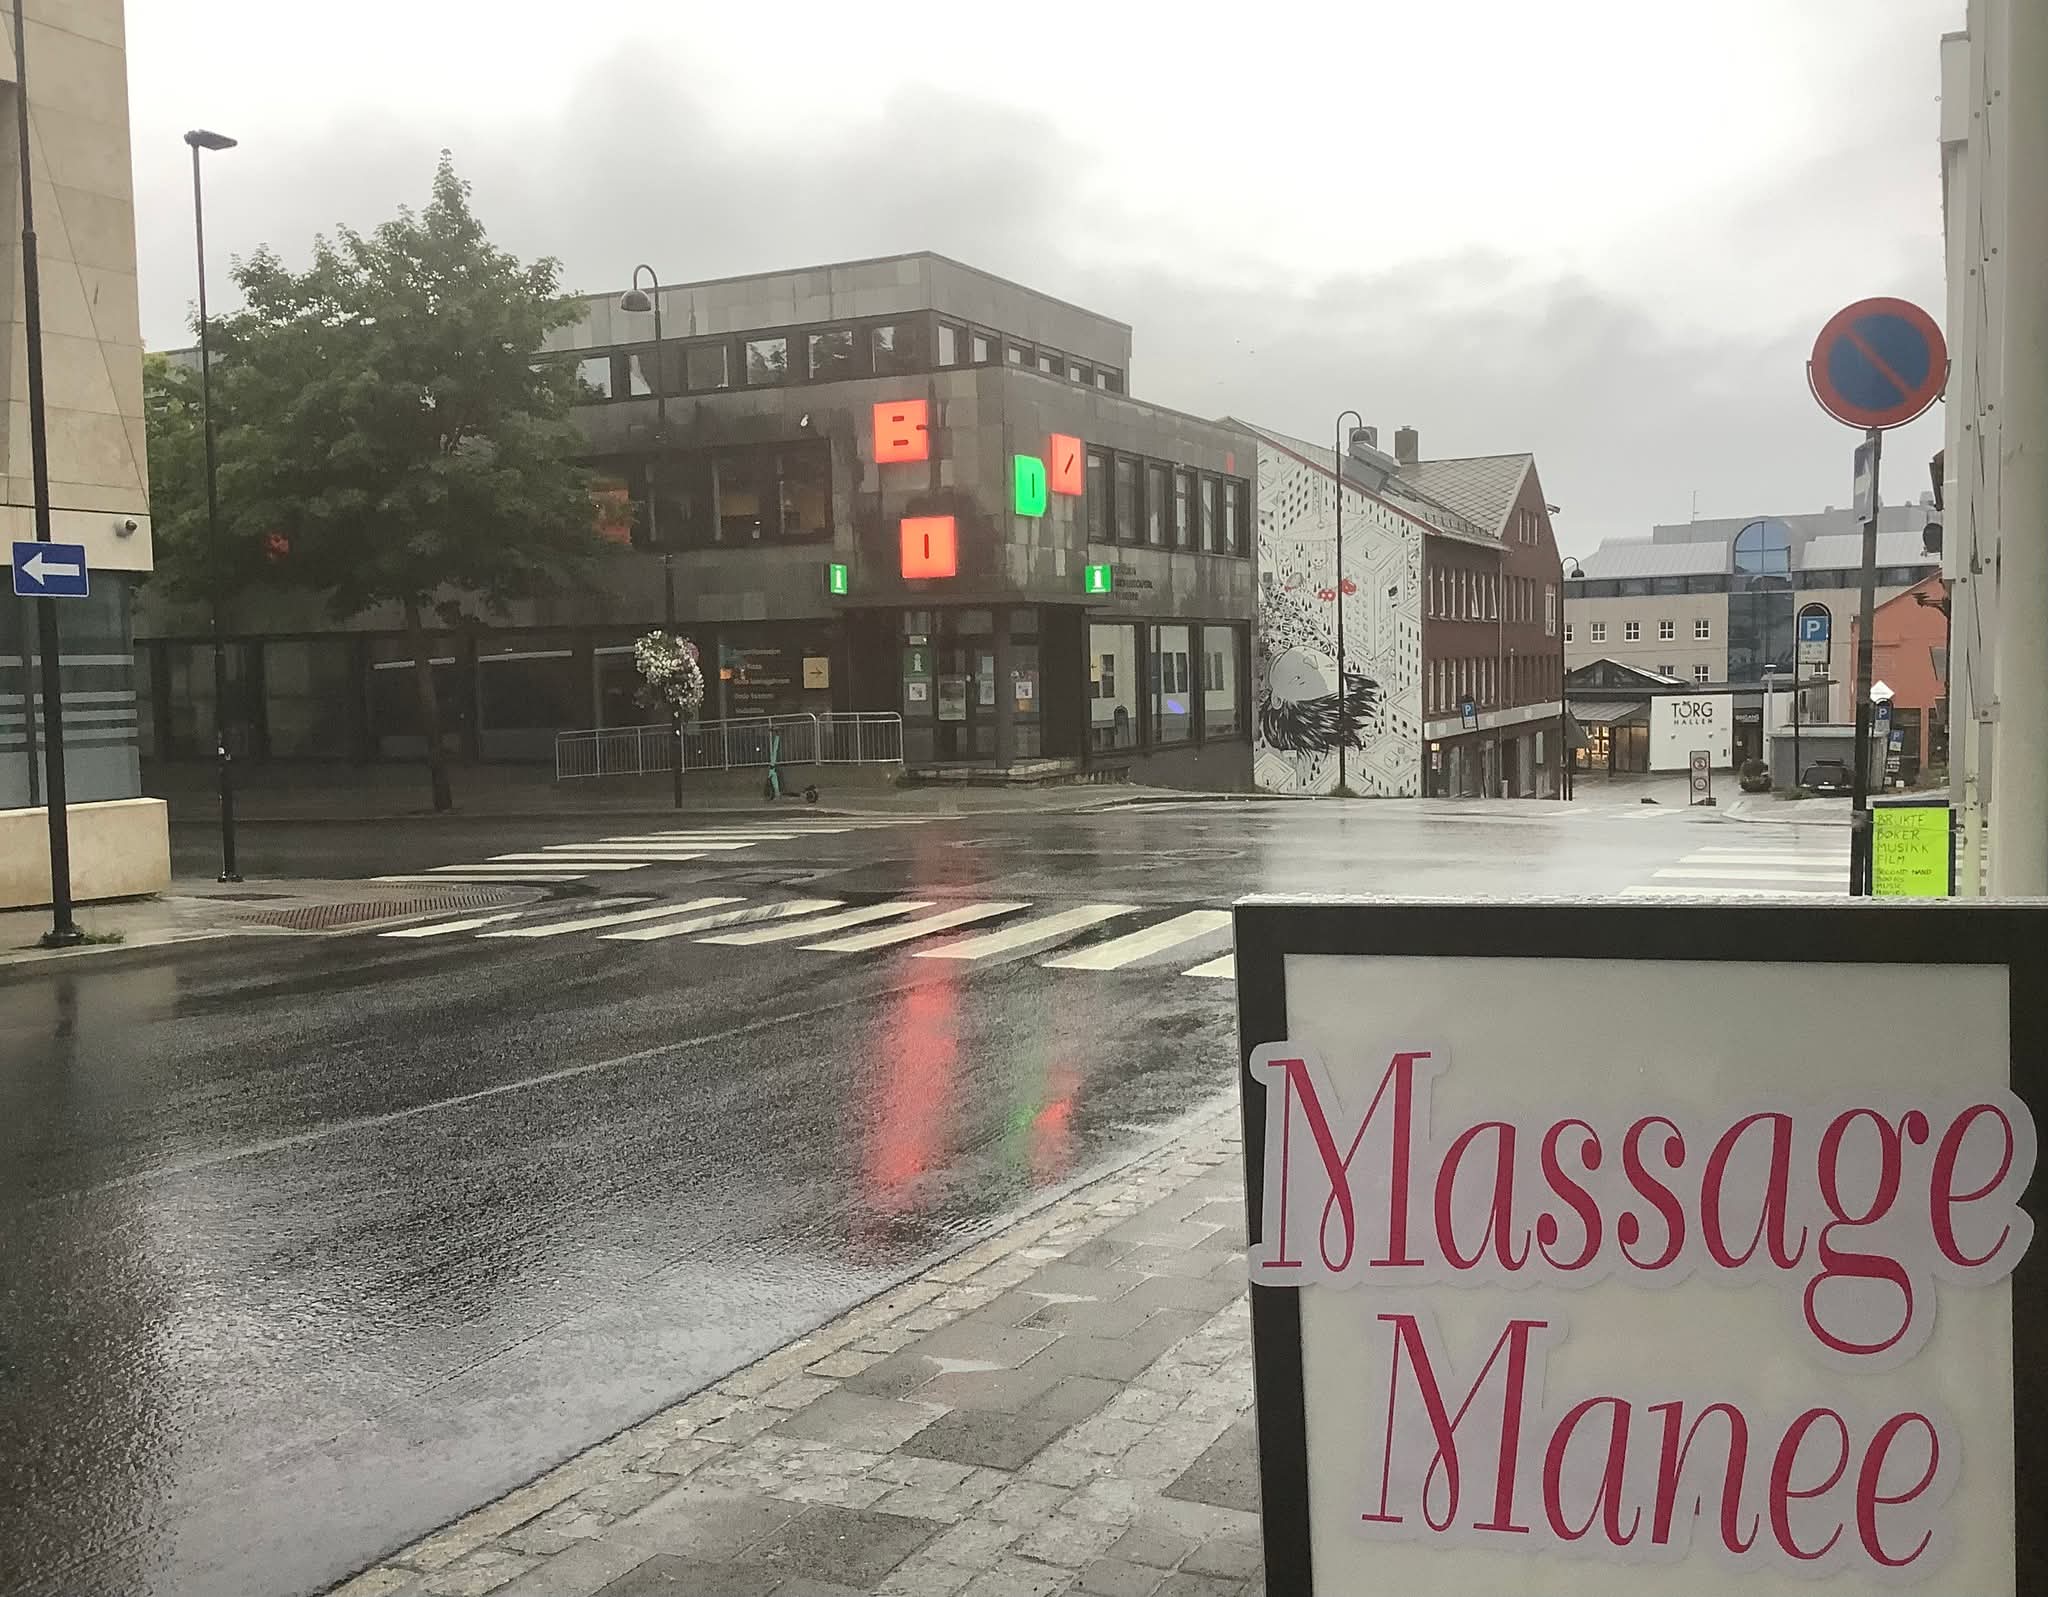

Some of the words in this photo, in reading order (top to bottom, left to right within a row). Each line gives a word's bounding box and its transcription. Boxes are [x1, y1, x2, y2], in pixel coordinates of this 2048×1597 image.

[1806, 620, 1821, 639] P
[1673, 718, 1713, 726] HALLEN
[1877, 854, 1905, 865] FILM
[1262, 1051, 2014, 1355] Massage
[1361, 1313, 1940, 1566] Manee
